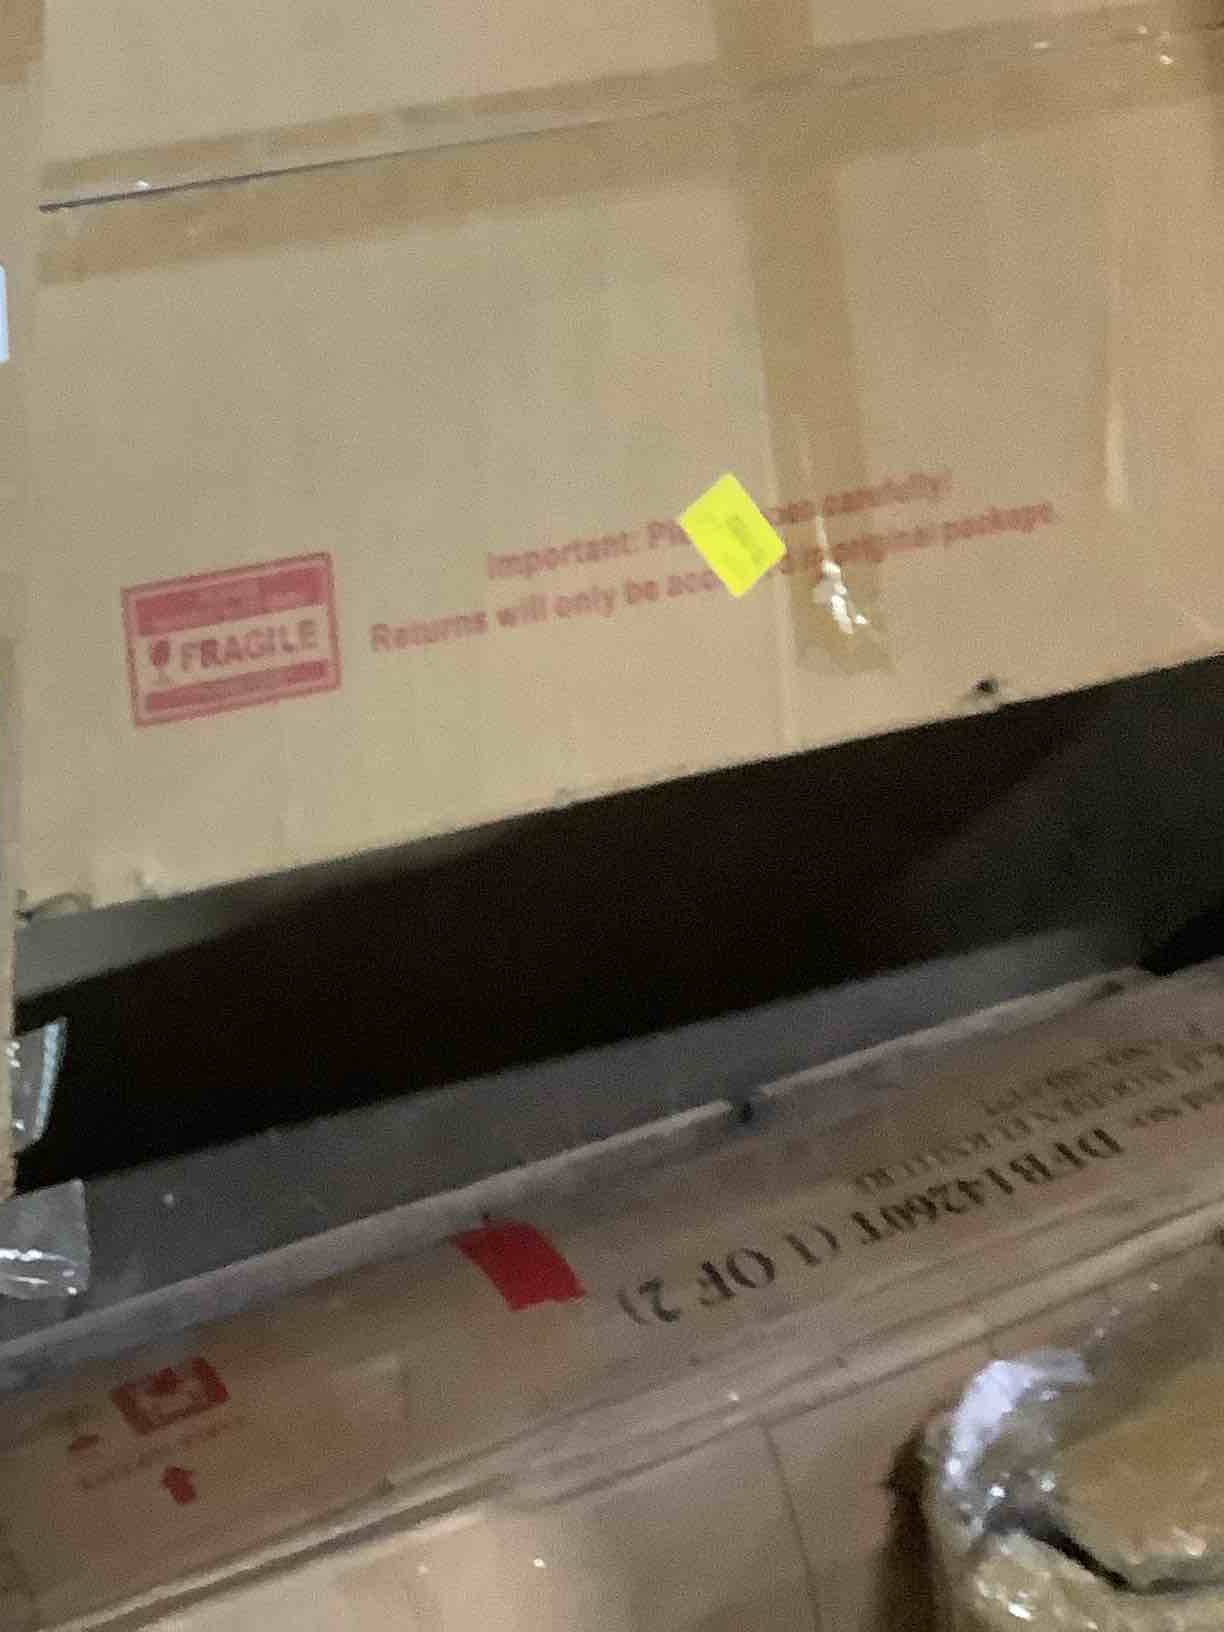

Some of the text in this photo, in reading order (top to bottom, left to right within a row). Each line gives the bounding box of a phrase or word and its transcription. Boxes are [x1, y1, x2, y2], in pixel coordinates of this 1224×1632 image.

[181, 619, 319, 673] FRAGILE
[617, 1276, 681, 1326] 2)
[698, 1248, 776, 1306] OF
